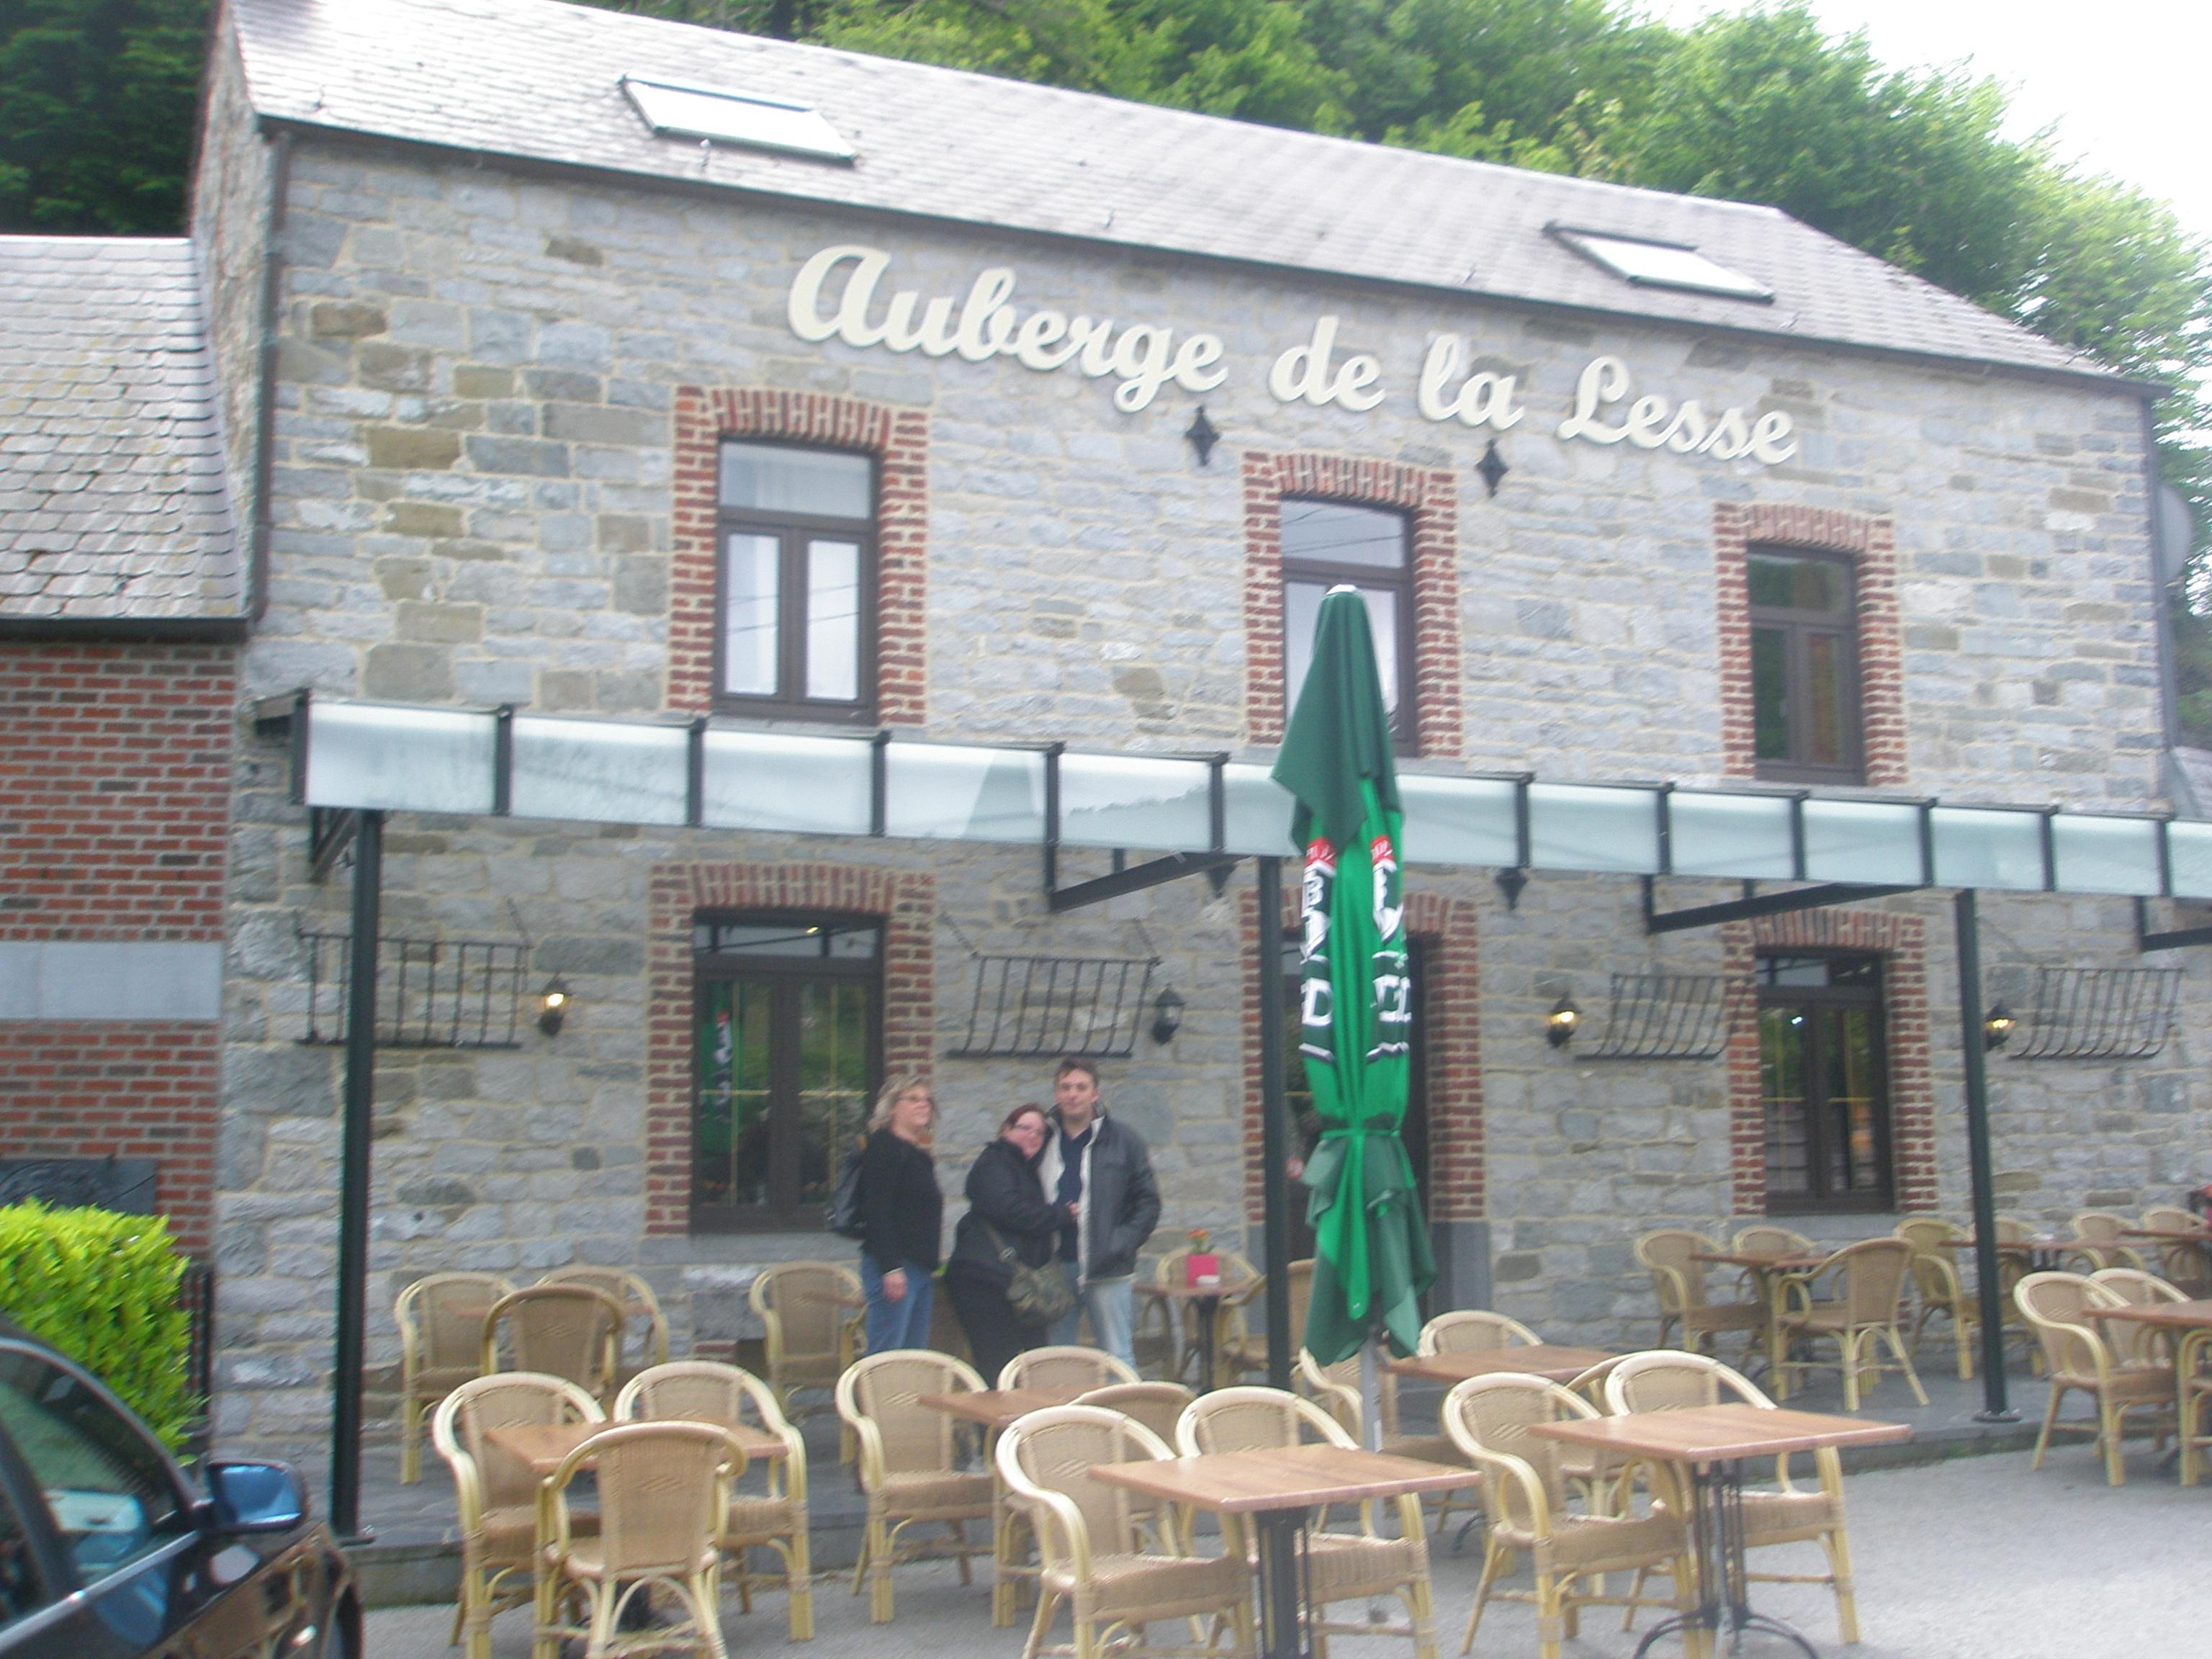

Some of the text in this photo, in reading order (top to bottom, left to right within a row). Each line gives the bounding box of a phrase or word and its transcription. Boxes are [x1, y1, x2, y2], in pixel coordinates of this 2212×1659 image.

[787, 245, 1799, 465] Auberge de la Lesse
